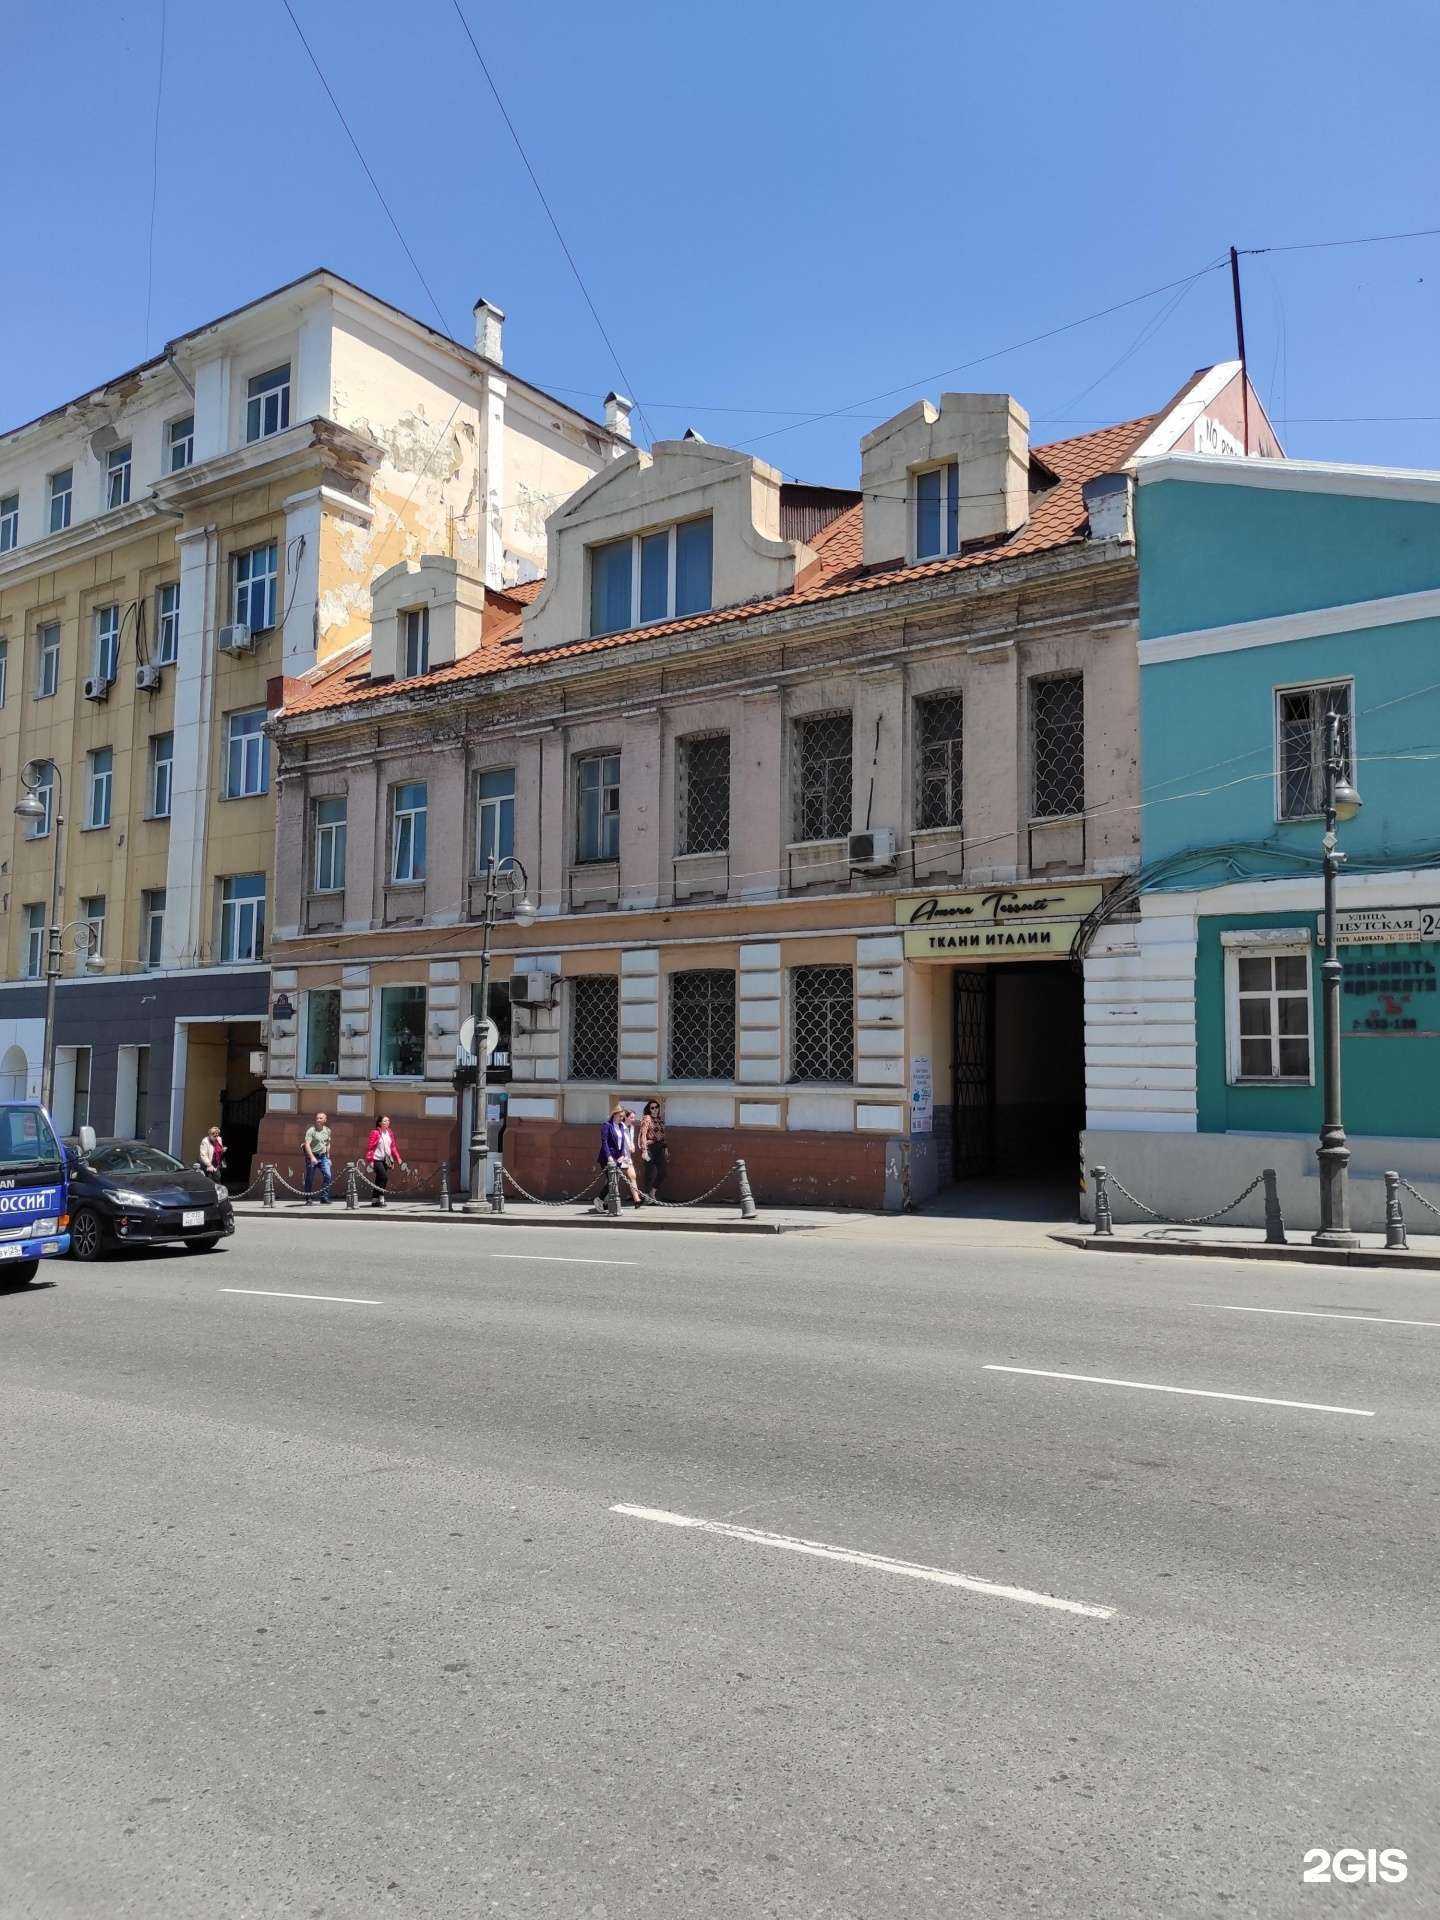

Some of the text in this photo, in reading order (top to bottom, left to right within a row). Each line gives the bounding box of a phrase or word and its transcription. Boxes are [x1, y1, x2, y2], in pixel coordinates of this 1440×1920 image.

[1348, 913, 1387, 922] УЛИЦА
[1336, 920, 1413, 932] ЛЕУТСКАЯ
[929, 931, 1052, 949] ТКАНИ ИТАЛИИ
[0, 1179, 15, 1188] AN
[0, 1194, 45, 1212] ОССИИ
